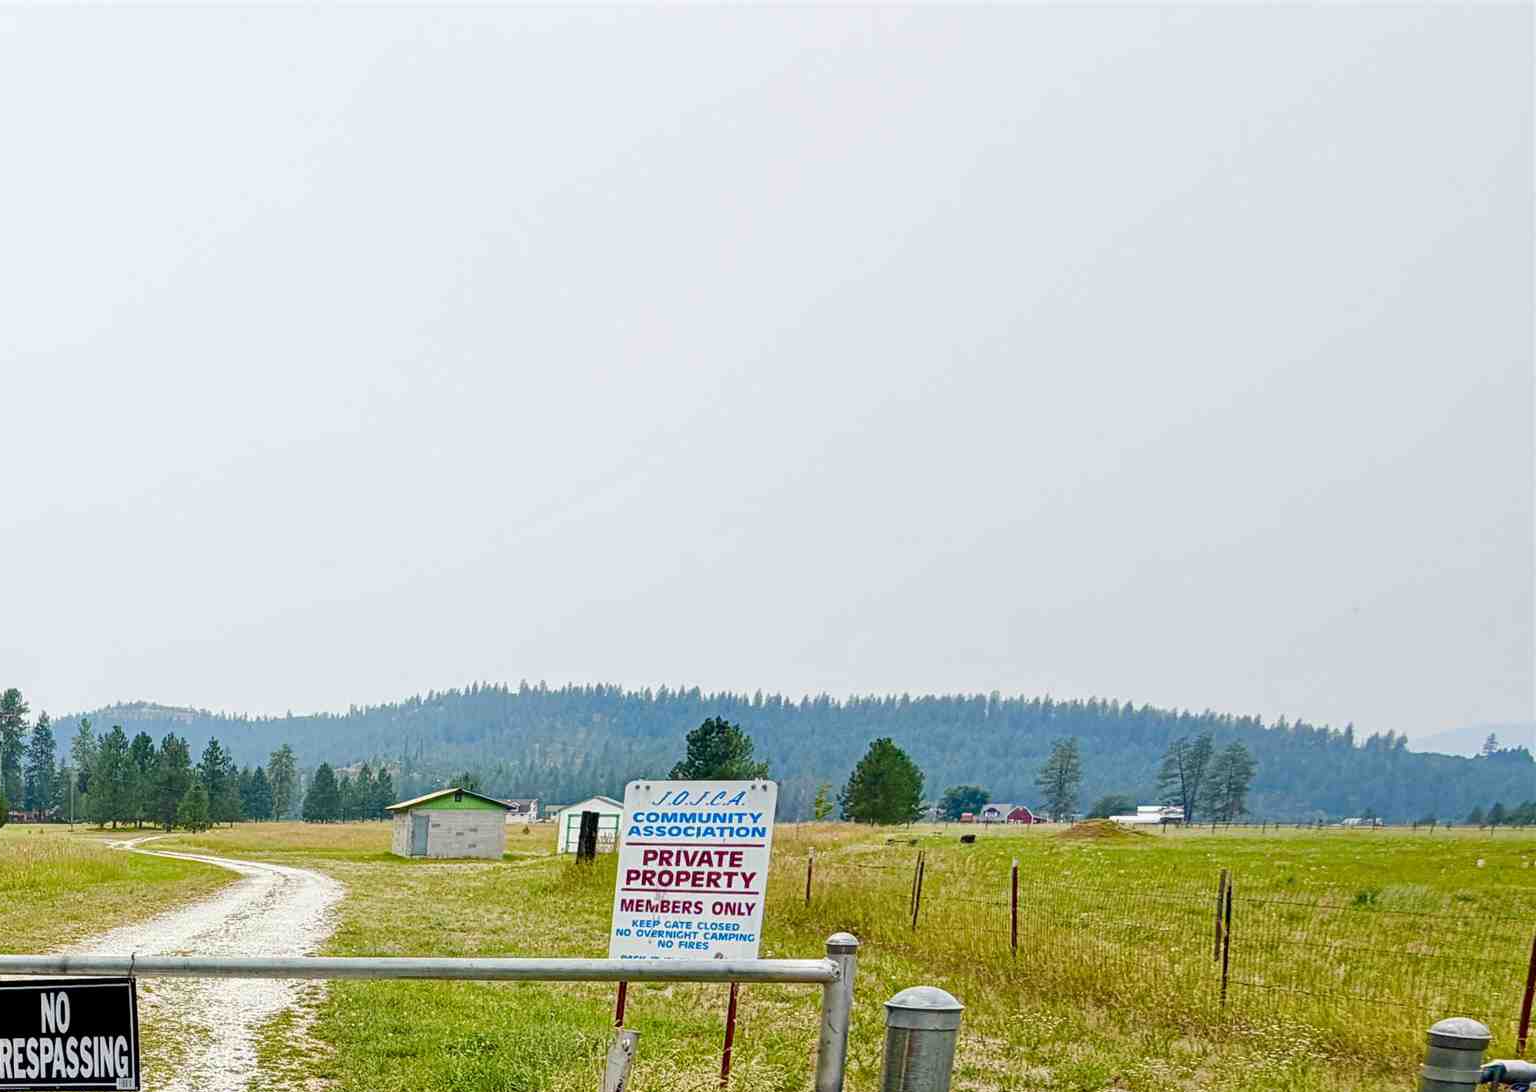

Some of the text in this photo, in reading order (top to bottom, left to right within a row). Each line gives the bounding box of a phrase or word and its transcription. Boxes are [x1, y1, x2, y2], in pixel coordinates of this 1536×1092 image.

[632, 812, 763, 823] COMMUNITY
[627, 826, 767, 838] ASSOCIATION
[642, 849, 744, 868] PRIVATE
[625, 869, 757, 889] PROPERTY
[620, 898, 756, 916] MEMBERS ONLY
[631, 919, 740, 931] KEEP GATE CLOSED
[616, 928, 755, 942] NO OVERNIGHT CAMPING
[657, 940, 709, 950] NO FIRES
[40, 991, 71, 1034] NO
